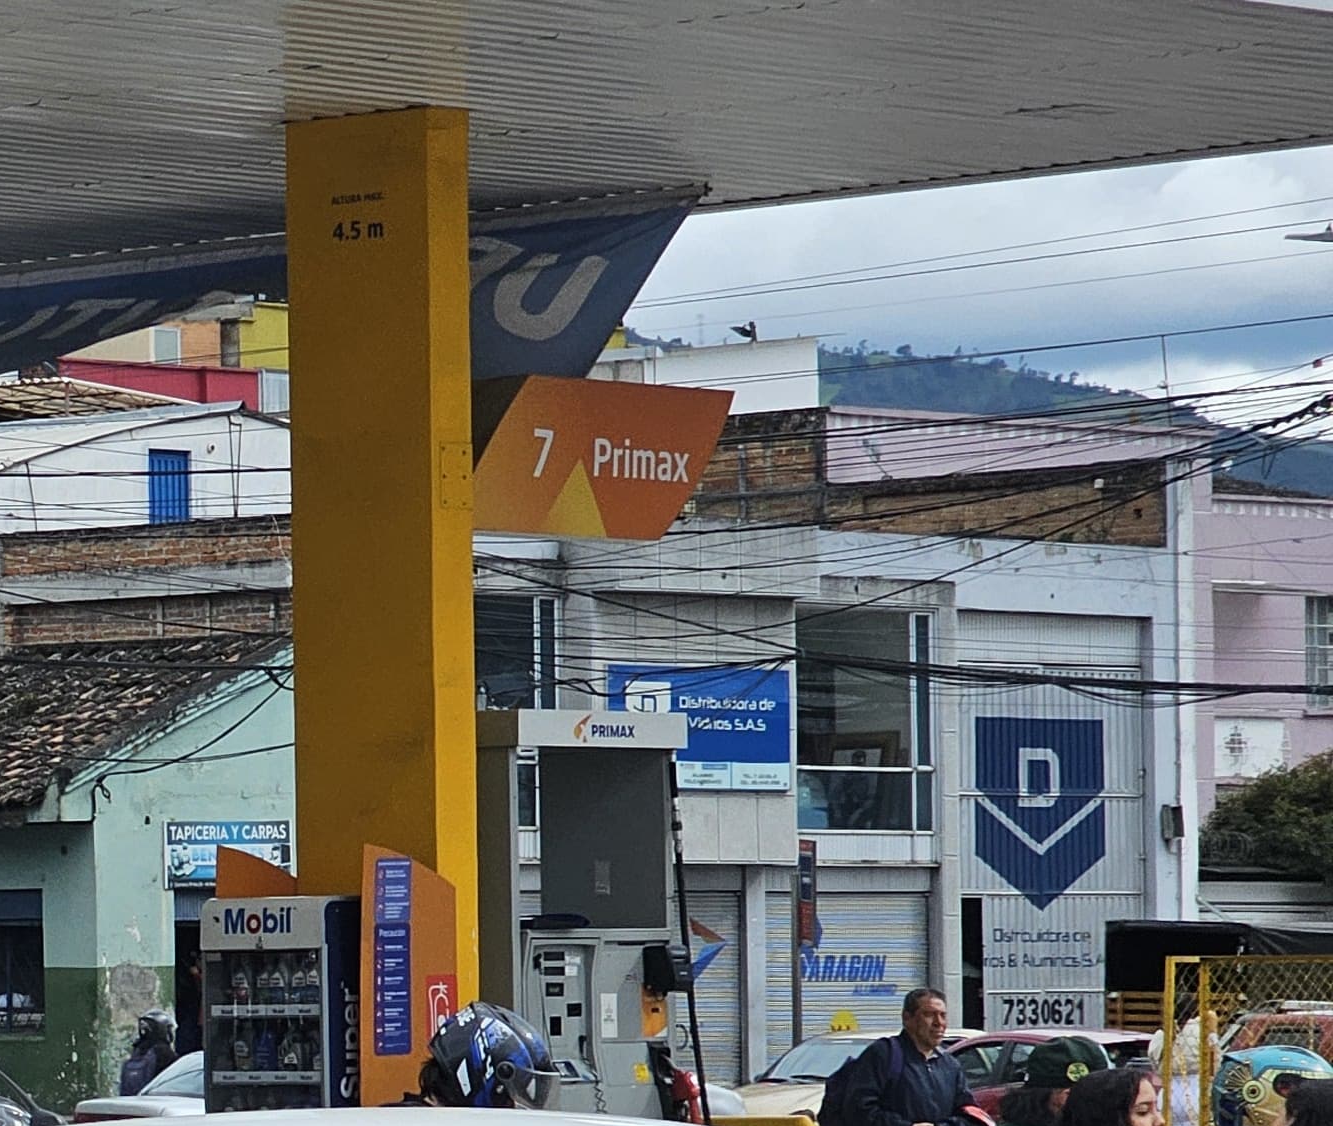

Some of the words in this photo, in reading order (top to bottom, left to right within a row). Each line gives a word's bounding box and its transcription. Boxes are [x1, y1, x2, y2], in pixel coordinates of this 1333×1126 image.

[332, 220, 361, 240] 4.5
[368, 222, 384, 239] m
[533, 428, 554, 477] 7
[593, 438, 689, 483] Primax
[679, 695, 757, 711] Distribuidora
[758, 697, 776, 712] de
[591, 724, 635, 739] PRIMAX
[1018, 747, 1060, 807] D
[169, 825, 229, 840] TAPICERIA
[231, 825, 240, 839] Y
[242, 824, 287, 839] CARPAS
[224, 907, 292, 934] Mobil
[1002, 998, 1084, 1025] 7330621
